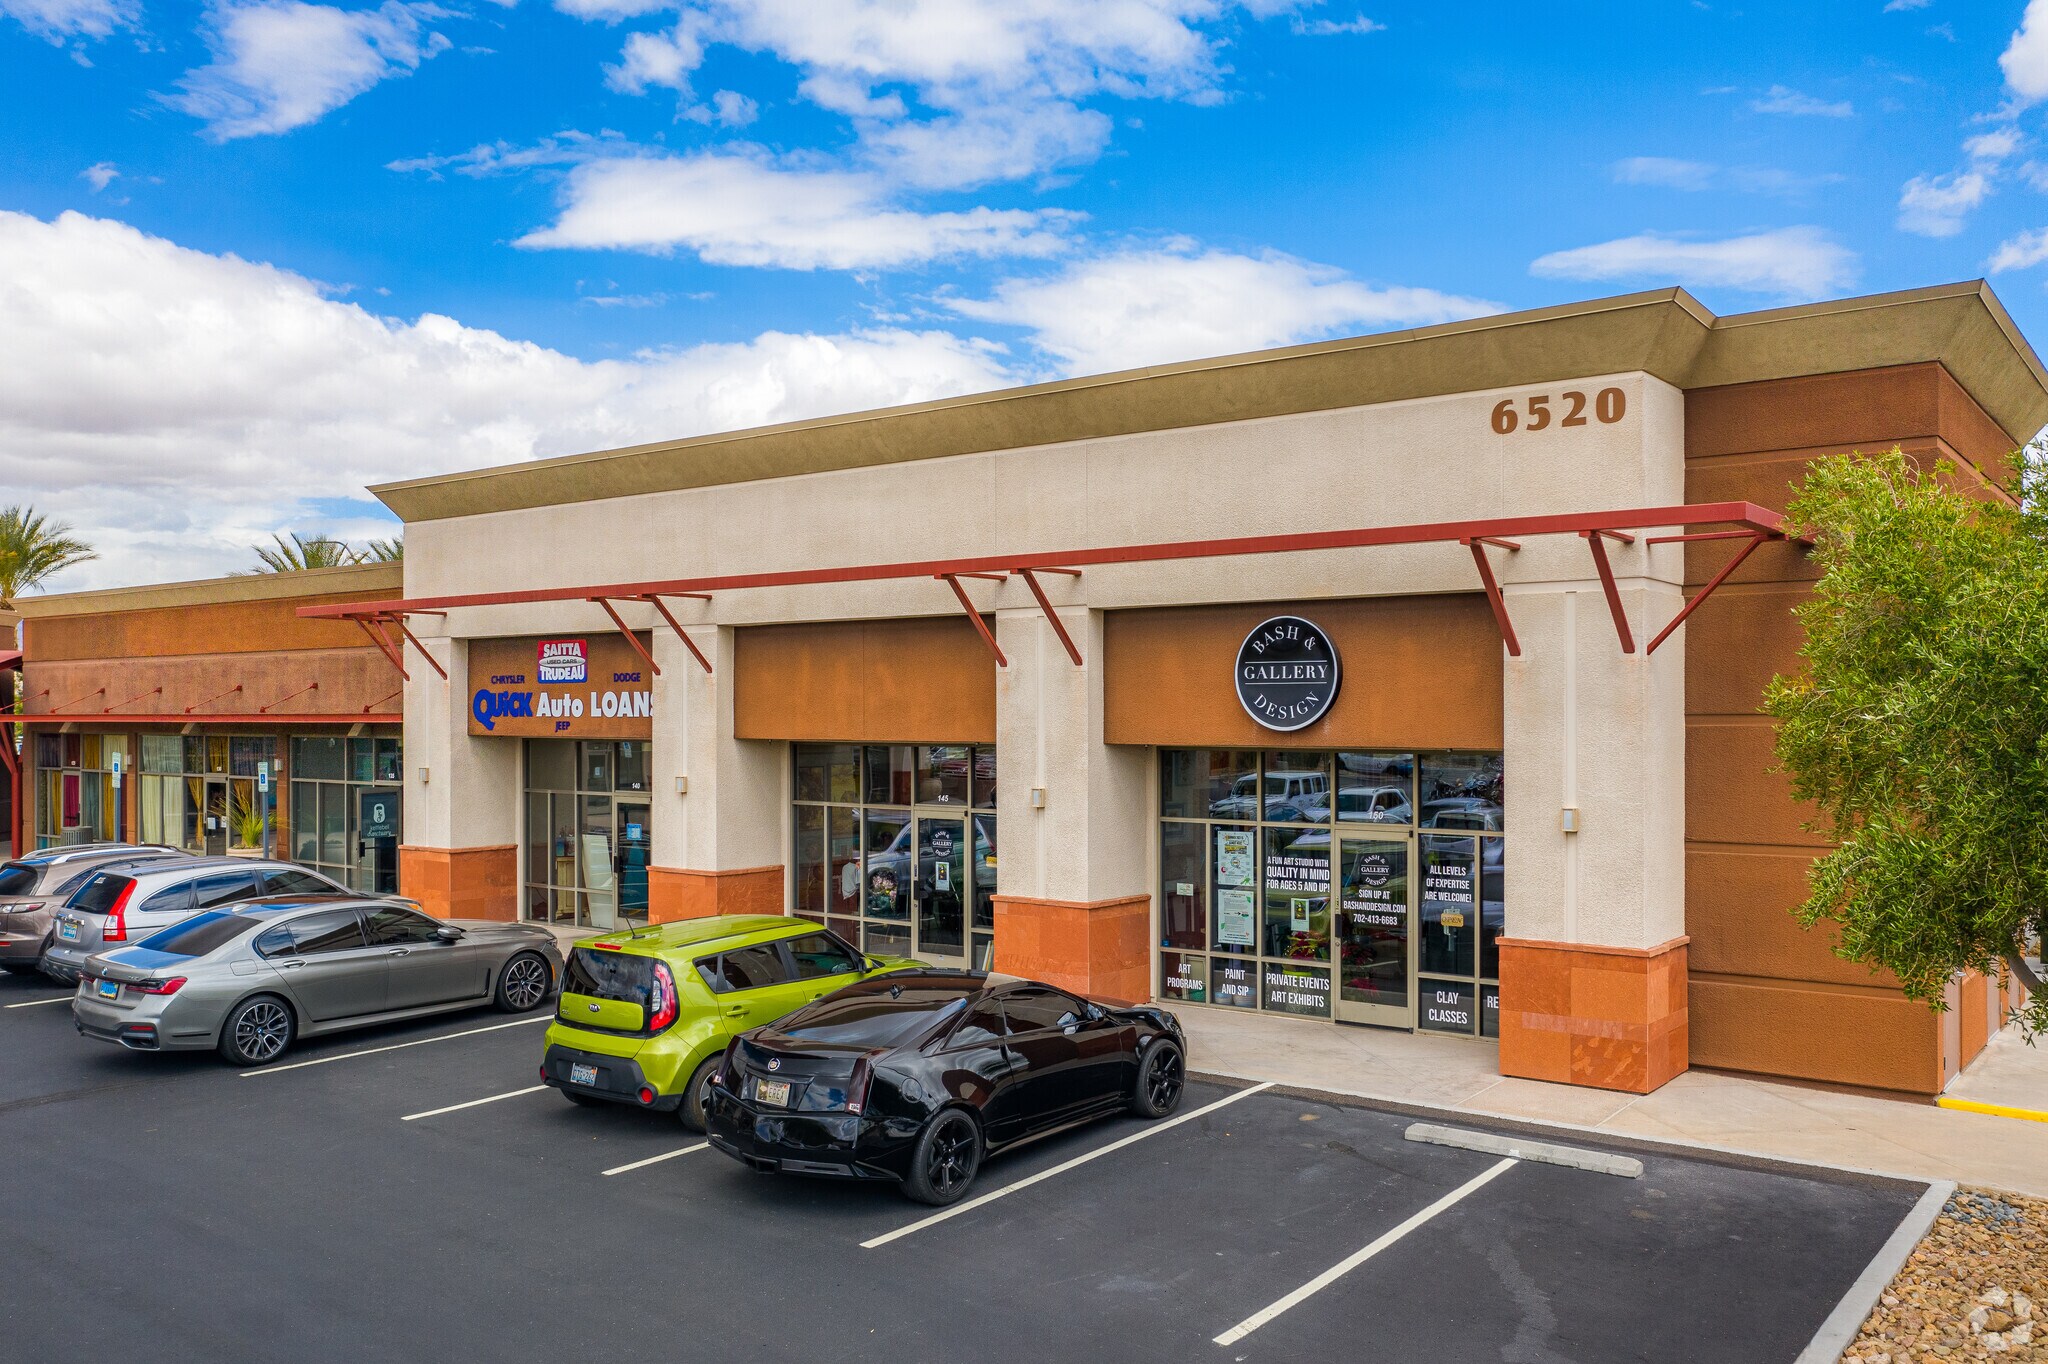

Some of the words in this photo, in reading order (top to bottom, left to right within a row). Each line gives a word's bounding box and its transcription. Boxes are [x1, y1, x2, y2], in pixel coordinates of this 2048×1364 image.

[1491, 387, 1626, 434] 6520
[1252, 625, 1300, 654] BASH
[1304, 636, 1316, 650] &
[543, 643, 582, 657] SAITTA
[540, 665, 585, 681] TRUDEAU
[613, 673, 641, 682] DODGE
[1244, 665, 1328, 679] GALLERY
[491, 675, 525, 684] CHRYSLER
[536, 692, 584, 717] Auto
[1253, 691, 1320, 719] DESIGN
[555, 721, 570, 732] JEEP
[1369, 811, 1384, 820] 150
[1267, 856, 1272, 864] A
[1272, 857, 1283, 865] FUN
[1284, 857, 1294, 866] ART
[1295, 858, 1314, 867] STUDIO
[1315, 859, 1329, 867] WITH
[1364, 854, 1380, 864] BASH
[1267, 866, 1299, 879] QUALITY
[1300, 868, 1308, 880] IN
[1310, 869, 1330, 881] MIND
[1430, 865, 1442, 875] ALL
[1443, 866, 1467, 876] LEVELS
[1267, 879, 1279, 889] FOR
[1280, 880, 1297, 891] AGES
[1298, 881, 1303, 891] 5
[1304, 882, 1318, 892] AND
[1319, 883, 1330, 893] UP!
[1365, 877, 1387, 886] DESIGN
[1426, 878, 1435, 887] OF
[1436, 879, 1470, 890] EXPERTISE
[1359, 889, 1373, 899] SIGN
[1373, 891, 1382, 899] UP
[1383, 891, 1391, 900] AT
[1425, 891, 1438, 901] ARE
[1438, 892, 1472, 903] WELCOME!
[1344, 901, 1407, 914] BASHANDDESIGN.COM
[1354, 914, 1398, 925] 702-413-6683
[1178, 963, 1192, 975] ART
[1225, 968, 1246, 981] PAINT
[1167, 976, 1203, 991] PROGRAMS
[1266, 972, 1298, 987] PRIVATE
[1299, 976, 1330, 991] EVENTS
[1221, 983, 1237, 995] AND
[1237, 984, 1249, 997] SIP
[1271, 990, 1286, 1003] ART
[1288, 993, 1325, 1008] EXHIBITS
[1436, 990, 1459, 1005] CLAY
[1428, 1008, 1468, 1024] CLASSES
